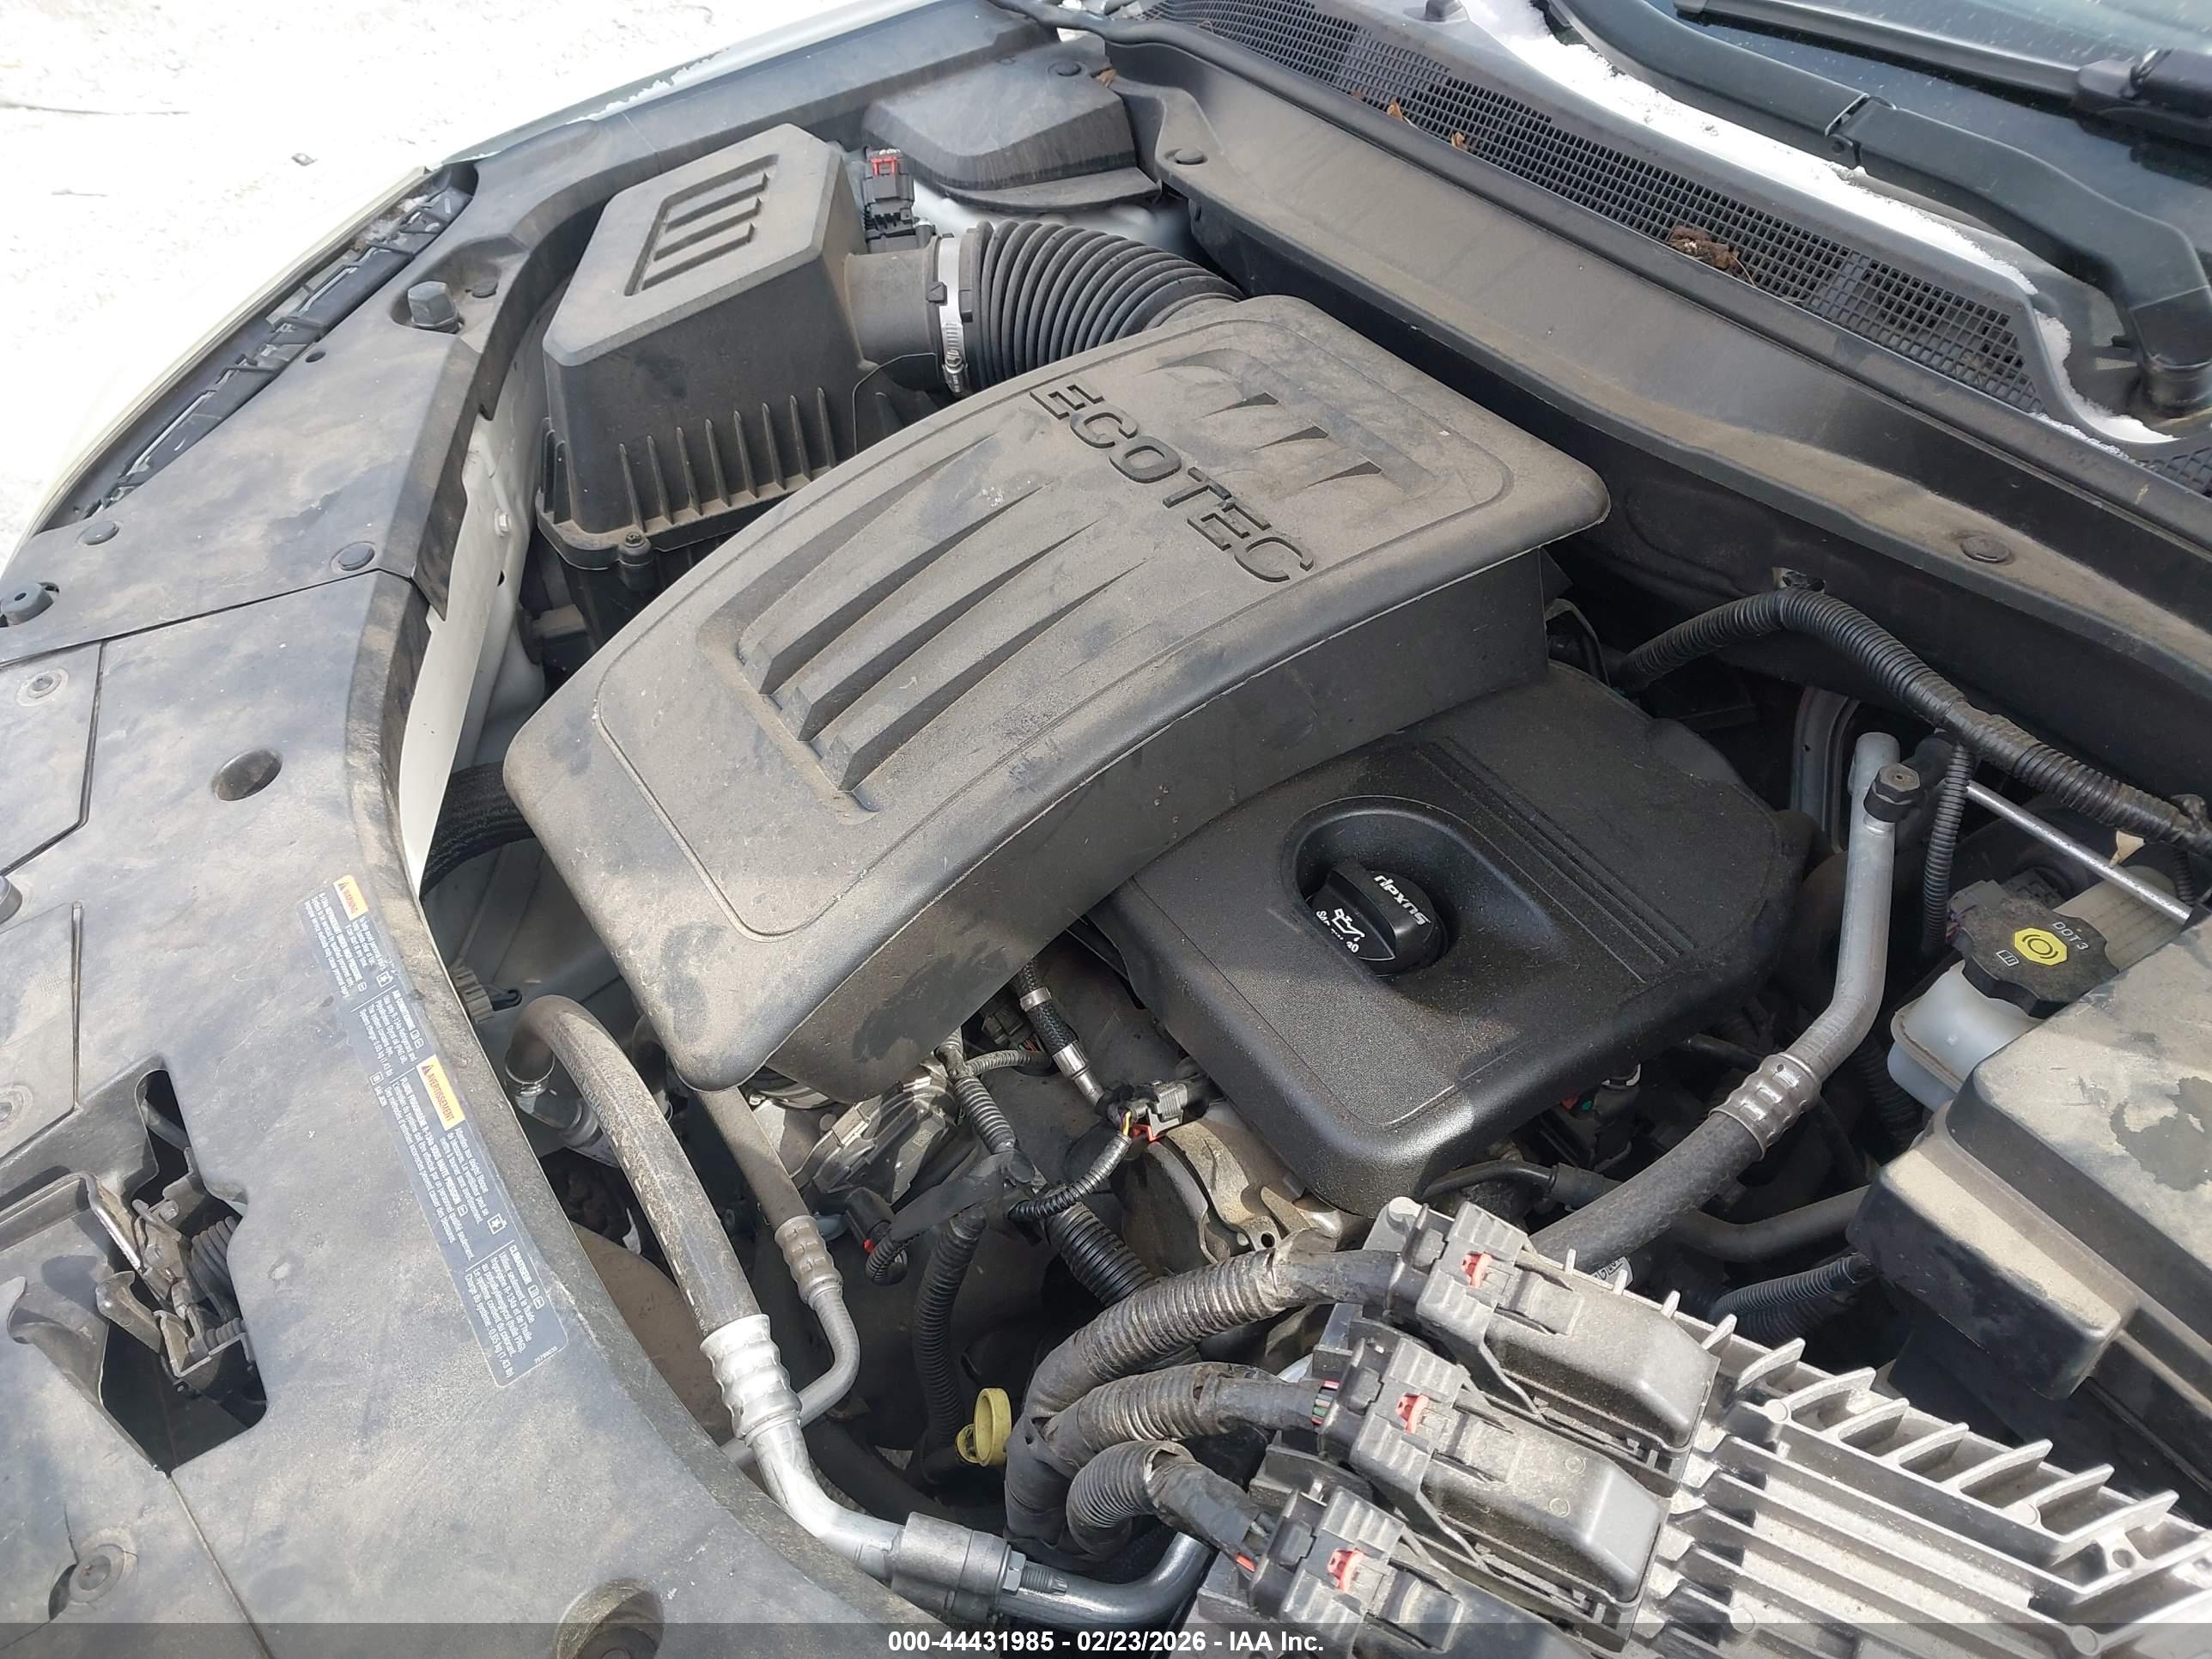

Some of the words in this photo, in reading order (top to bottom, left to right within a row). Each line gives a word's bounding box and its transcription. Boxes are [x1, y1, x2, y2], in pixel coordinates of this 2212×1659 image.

[1029, 383, 1316, 583] ECOTEC
[2053, 921, 2081, 944] DOT
[426, 1072, 454, 1121] AVERTISSEMENT
[509, 1245, 532, 1285] CLIMATISEUR
